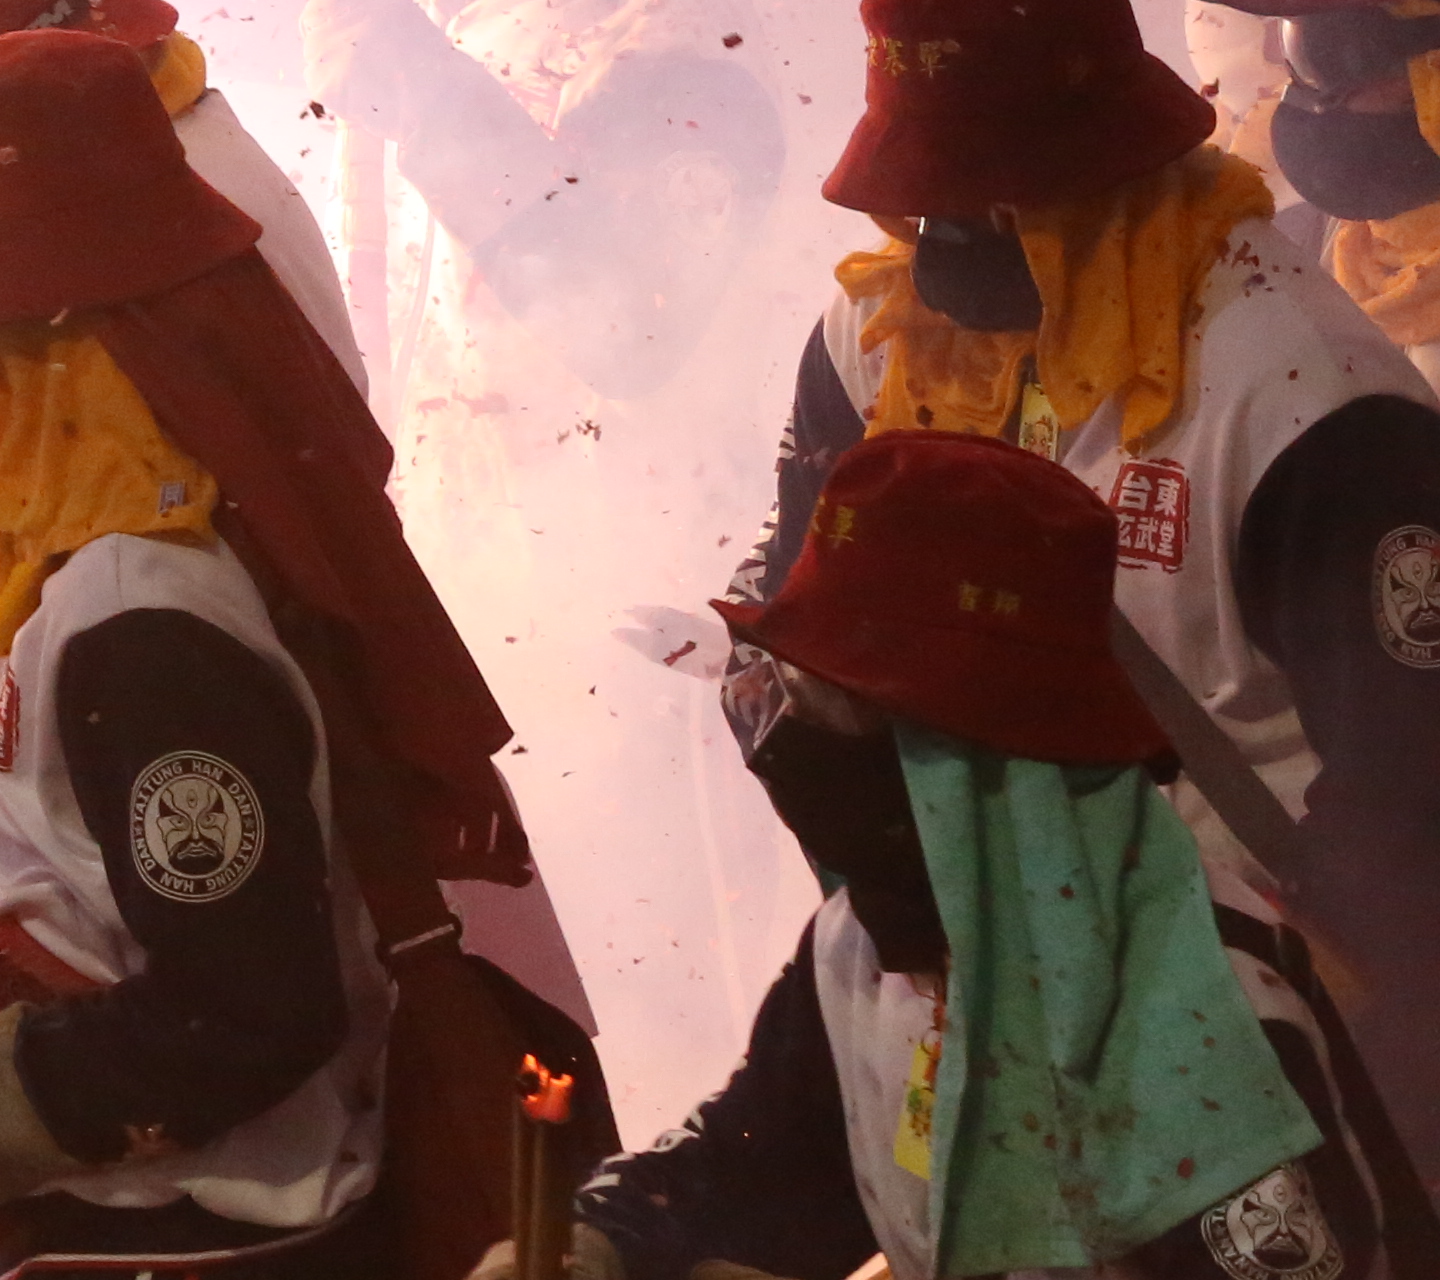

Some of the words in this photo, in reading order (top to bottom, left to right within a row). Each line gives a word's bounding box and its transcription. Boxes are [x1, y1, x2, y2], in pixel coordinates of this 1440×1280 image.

[135, 762, 183, 822] TAITUNG
[192, 760, 224, 781] HAN
[230, 783, 253, 816] DAN
[135, 838, 157, 871] DAN
[206, 831, 256, 890] TAITUNG
[160, 873, 194, 892] HAN
